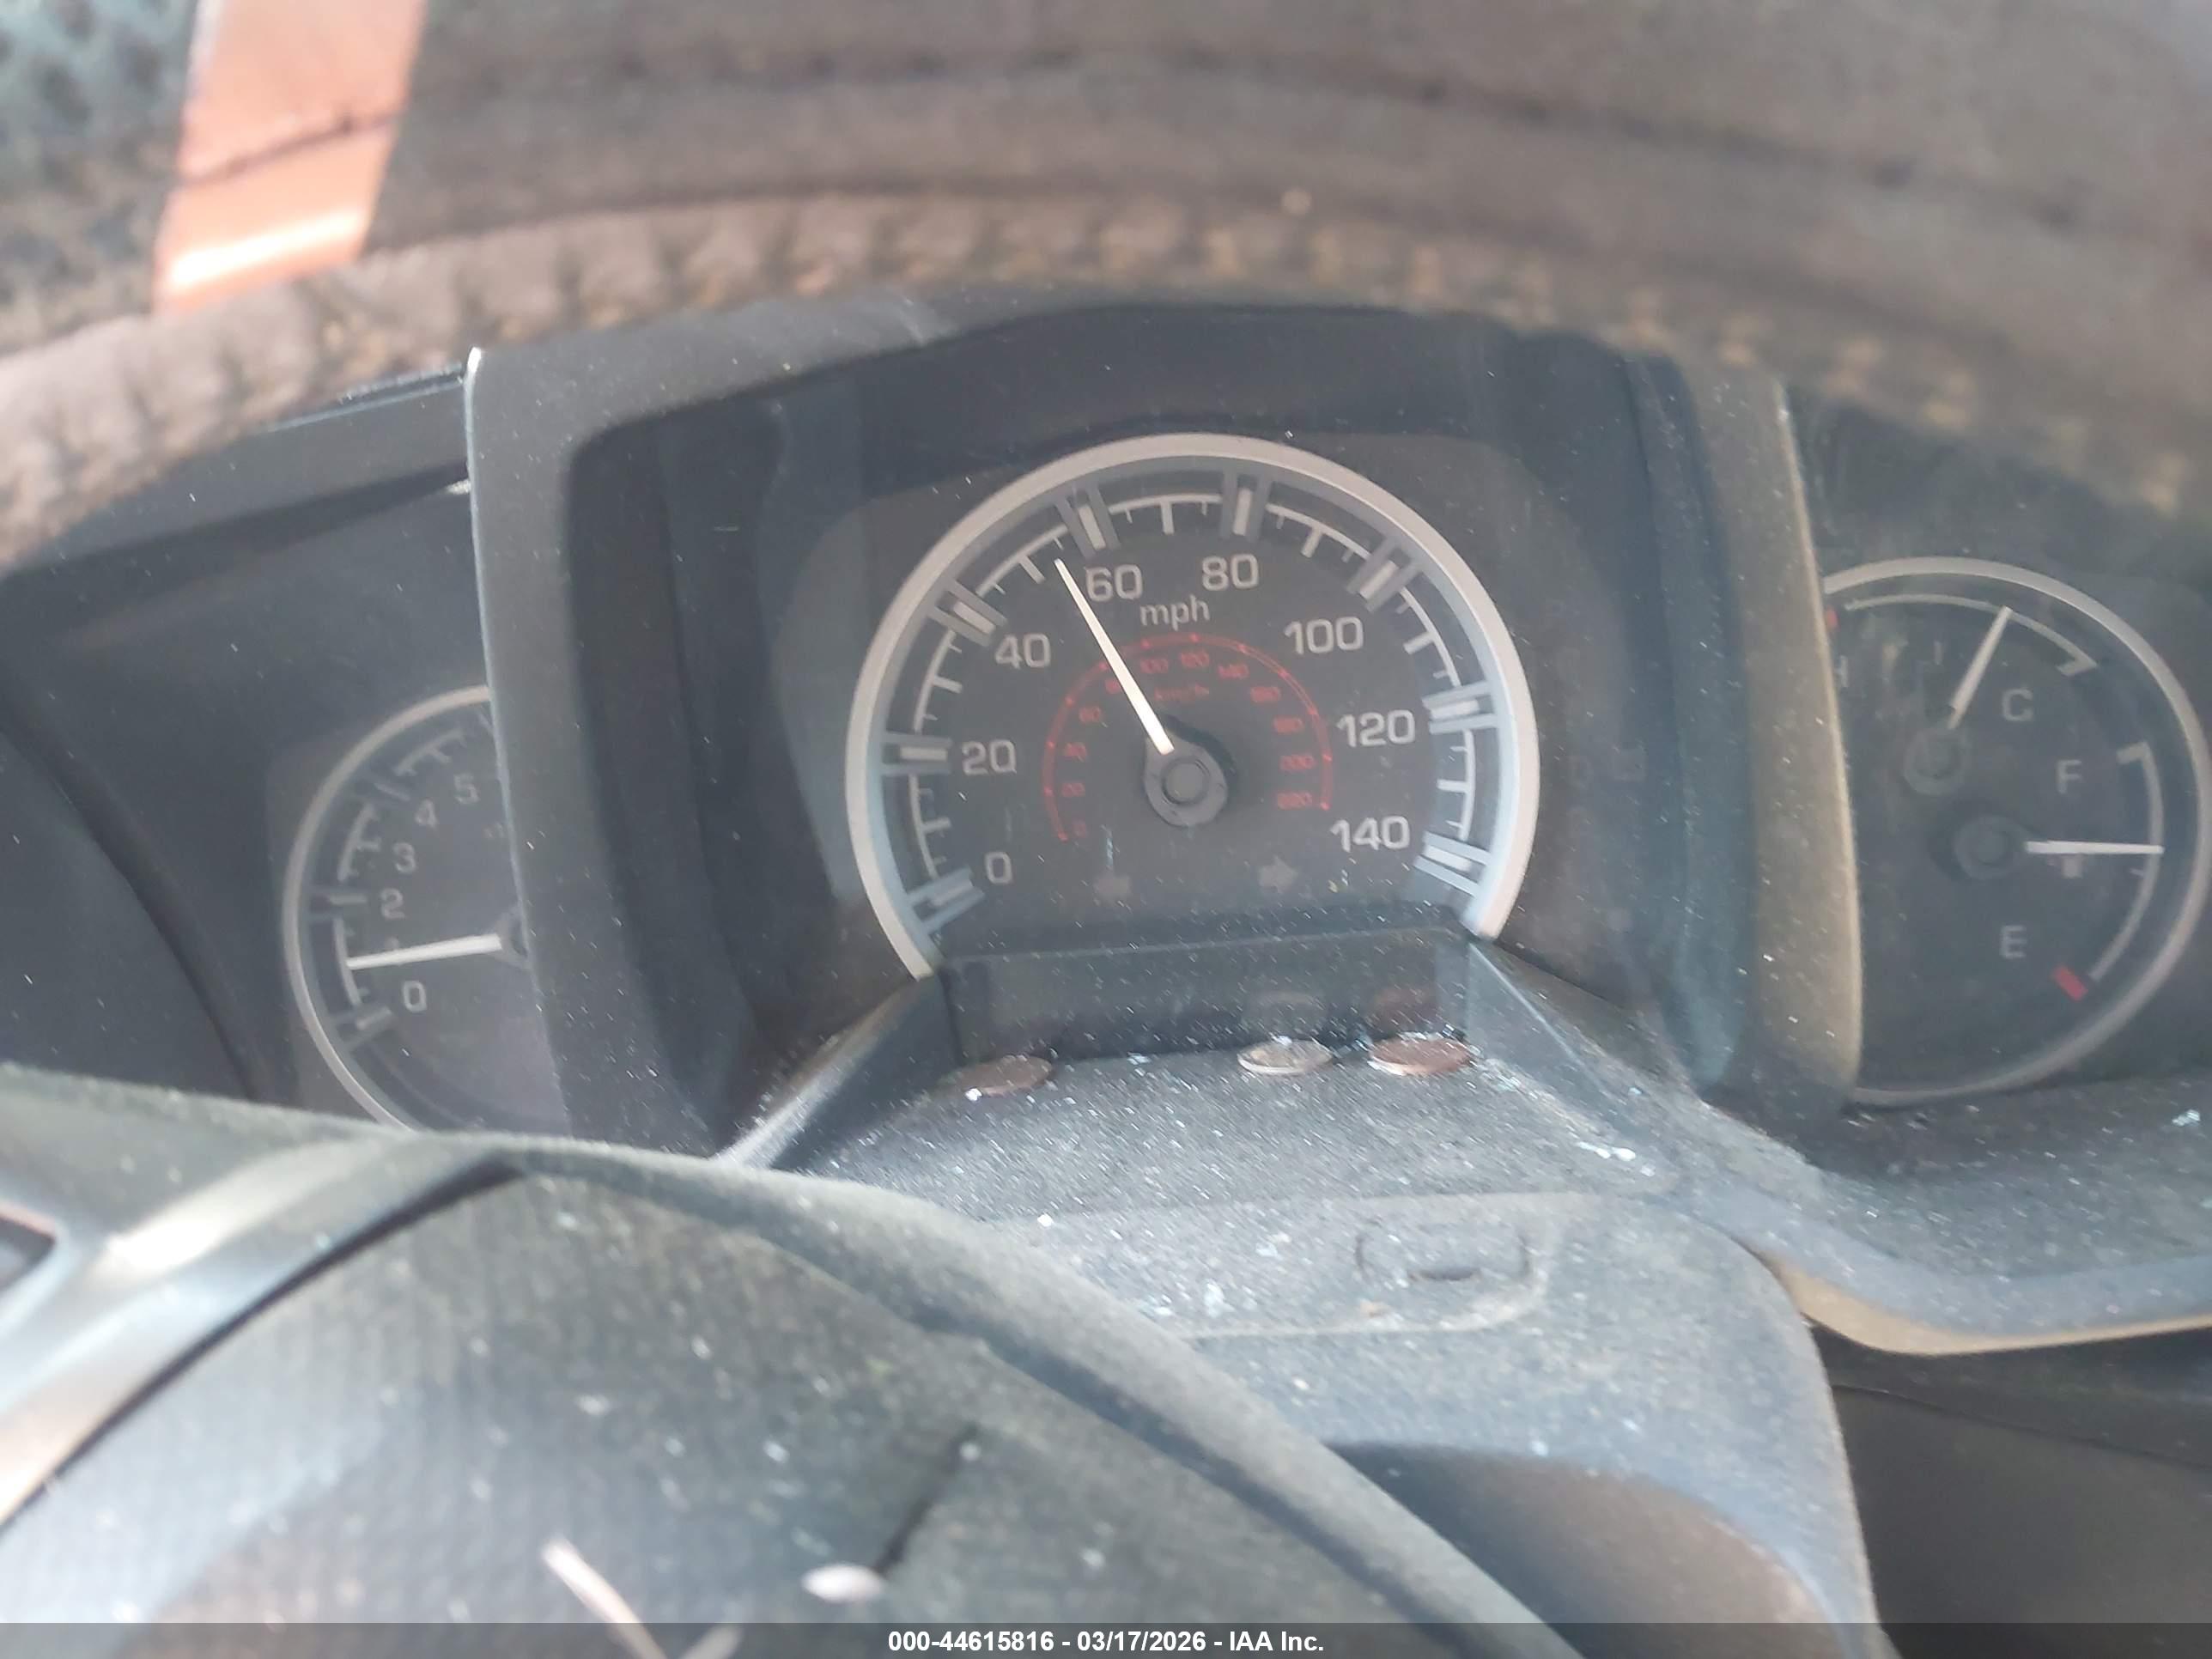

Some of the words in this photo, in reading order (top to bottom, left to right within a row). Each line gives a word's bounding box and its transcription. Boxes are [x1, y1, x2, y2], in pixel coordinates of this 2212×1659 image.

[1085, 564, 1143, 600] 60
[1202, 554, 1260, 590] 80
[1139, 596, 1210, 629] mph
[994, 633, 1052, 669] 40
[1284, 617, 1364, 654] 100
[2001, 689, 2033, 722] C
[1337, 709, 1416, 746] 120
[961, 740, 1018, 775] 20
[454, 774, 480, 805] 5
[2056, 760, 2084, 794] F
[414, 799, 439, 829] 4
[1330, 816, 1410, 852] 140
[394, 842, 416, 873] 3
[985, 852, 1012, 884] 0
[380, 888, 404, 920] 2
[2000, 925, 2027, 959] E
[402, 980, 428, 1013] 0
